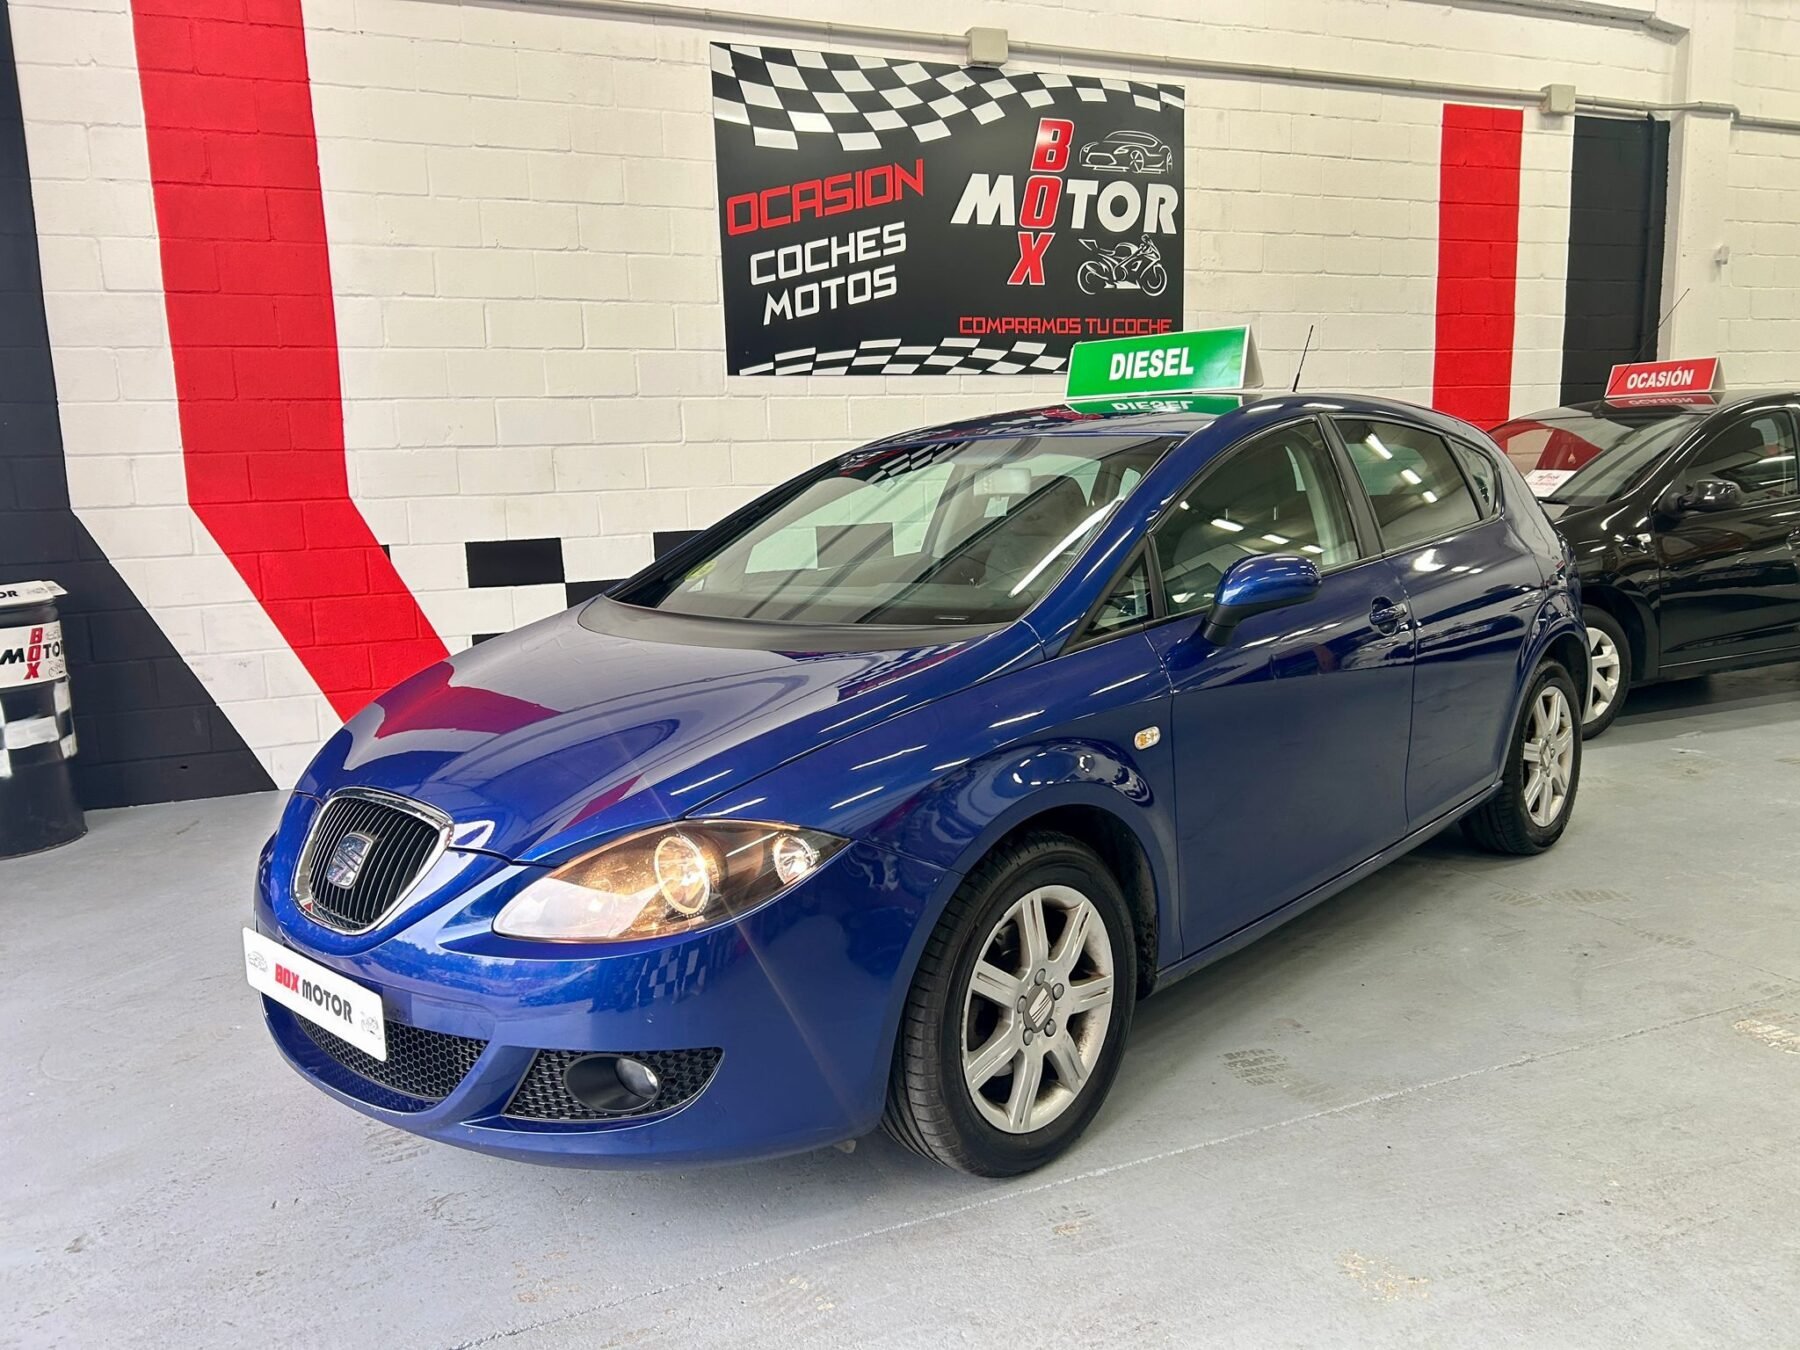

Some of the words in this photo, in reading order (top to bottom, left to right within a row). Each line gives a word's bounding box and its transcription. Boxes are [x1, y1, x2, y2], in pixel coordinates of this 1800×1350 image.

[726, 158, 925, 236] OCASION
[950, 173, 1179, 235] MOTOR
[1007, 117, 1075, 286] BOX
[750, 221, 907, 286] COCHES
[763, 264, 898, 326] MOTOS
[959, 316, 1081, 335] COMPRAMOS
[1085, 317, 1110, 335] TU
[1112, 317, 1173, 335] COCHE
[1108, 346, 1195, 382] DIESEL
[1626, 365, 1695, 390] OCASIÓN
[23, 626, 44, 680] BOX
[274, 962, 299, 994] BOX
[302, 978, 353, 1025] MOTOR
